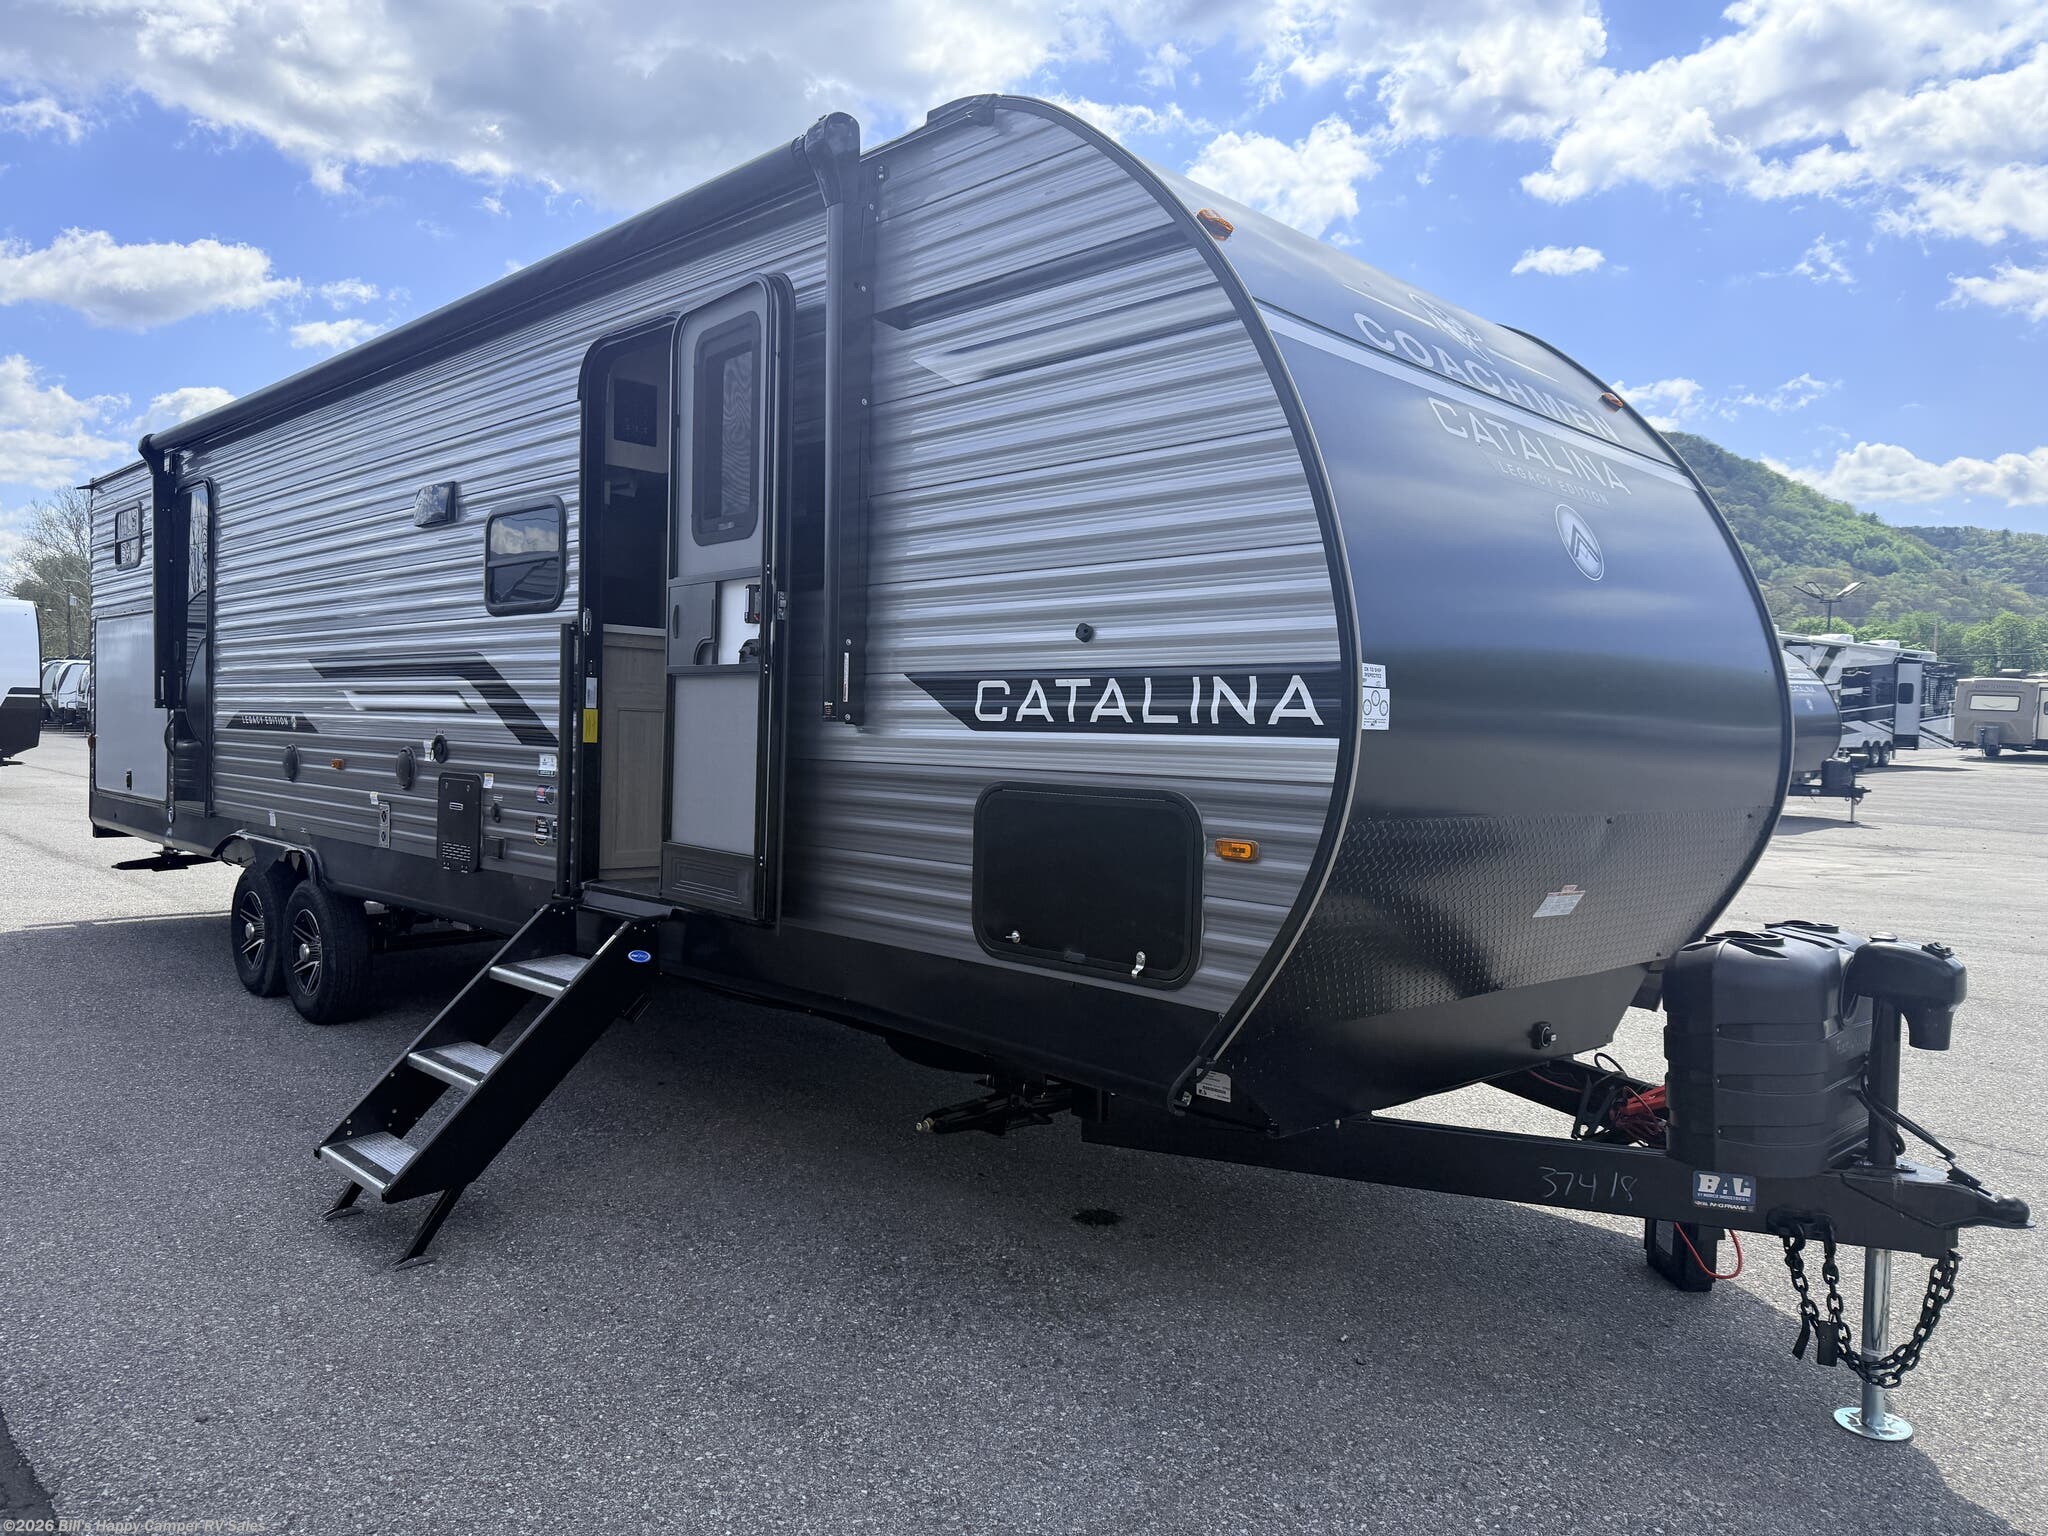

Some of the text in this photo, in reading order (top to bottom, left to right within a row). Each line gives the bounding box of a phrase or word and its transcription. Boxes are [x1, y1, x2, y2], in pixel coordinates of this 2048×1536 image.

[1353, 312, 1621, 442] COACHMEN
[1427, 396, 1632, 495] CATALINA
[1498, 461, 1610, 505] LEGACY EDITION
[241, 715, 289, 725] LEGACY EDITION
[974, 673, 1325, 726] CATALINA
[1698, 1174, 1752, 1197] BAL
